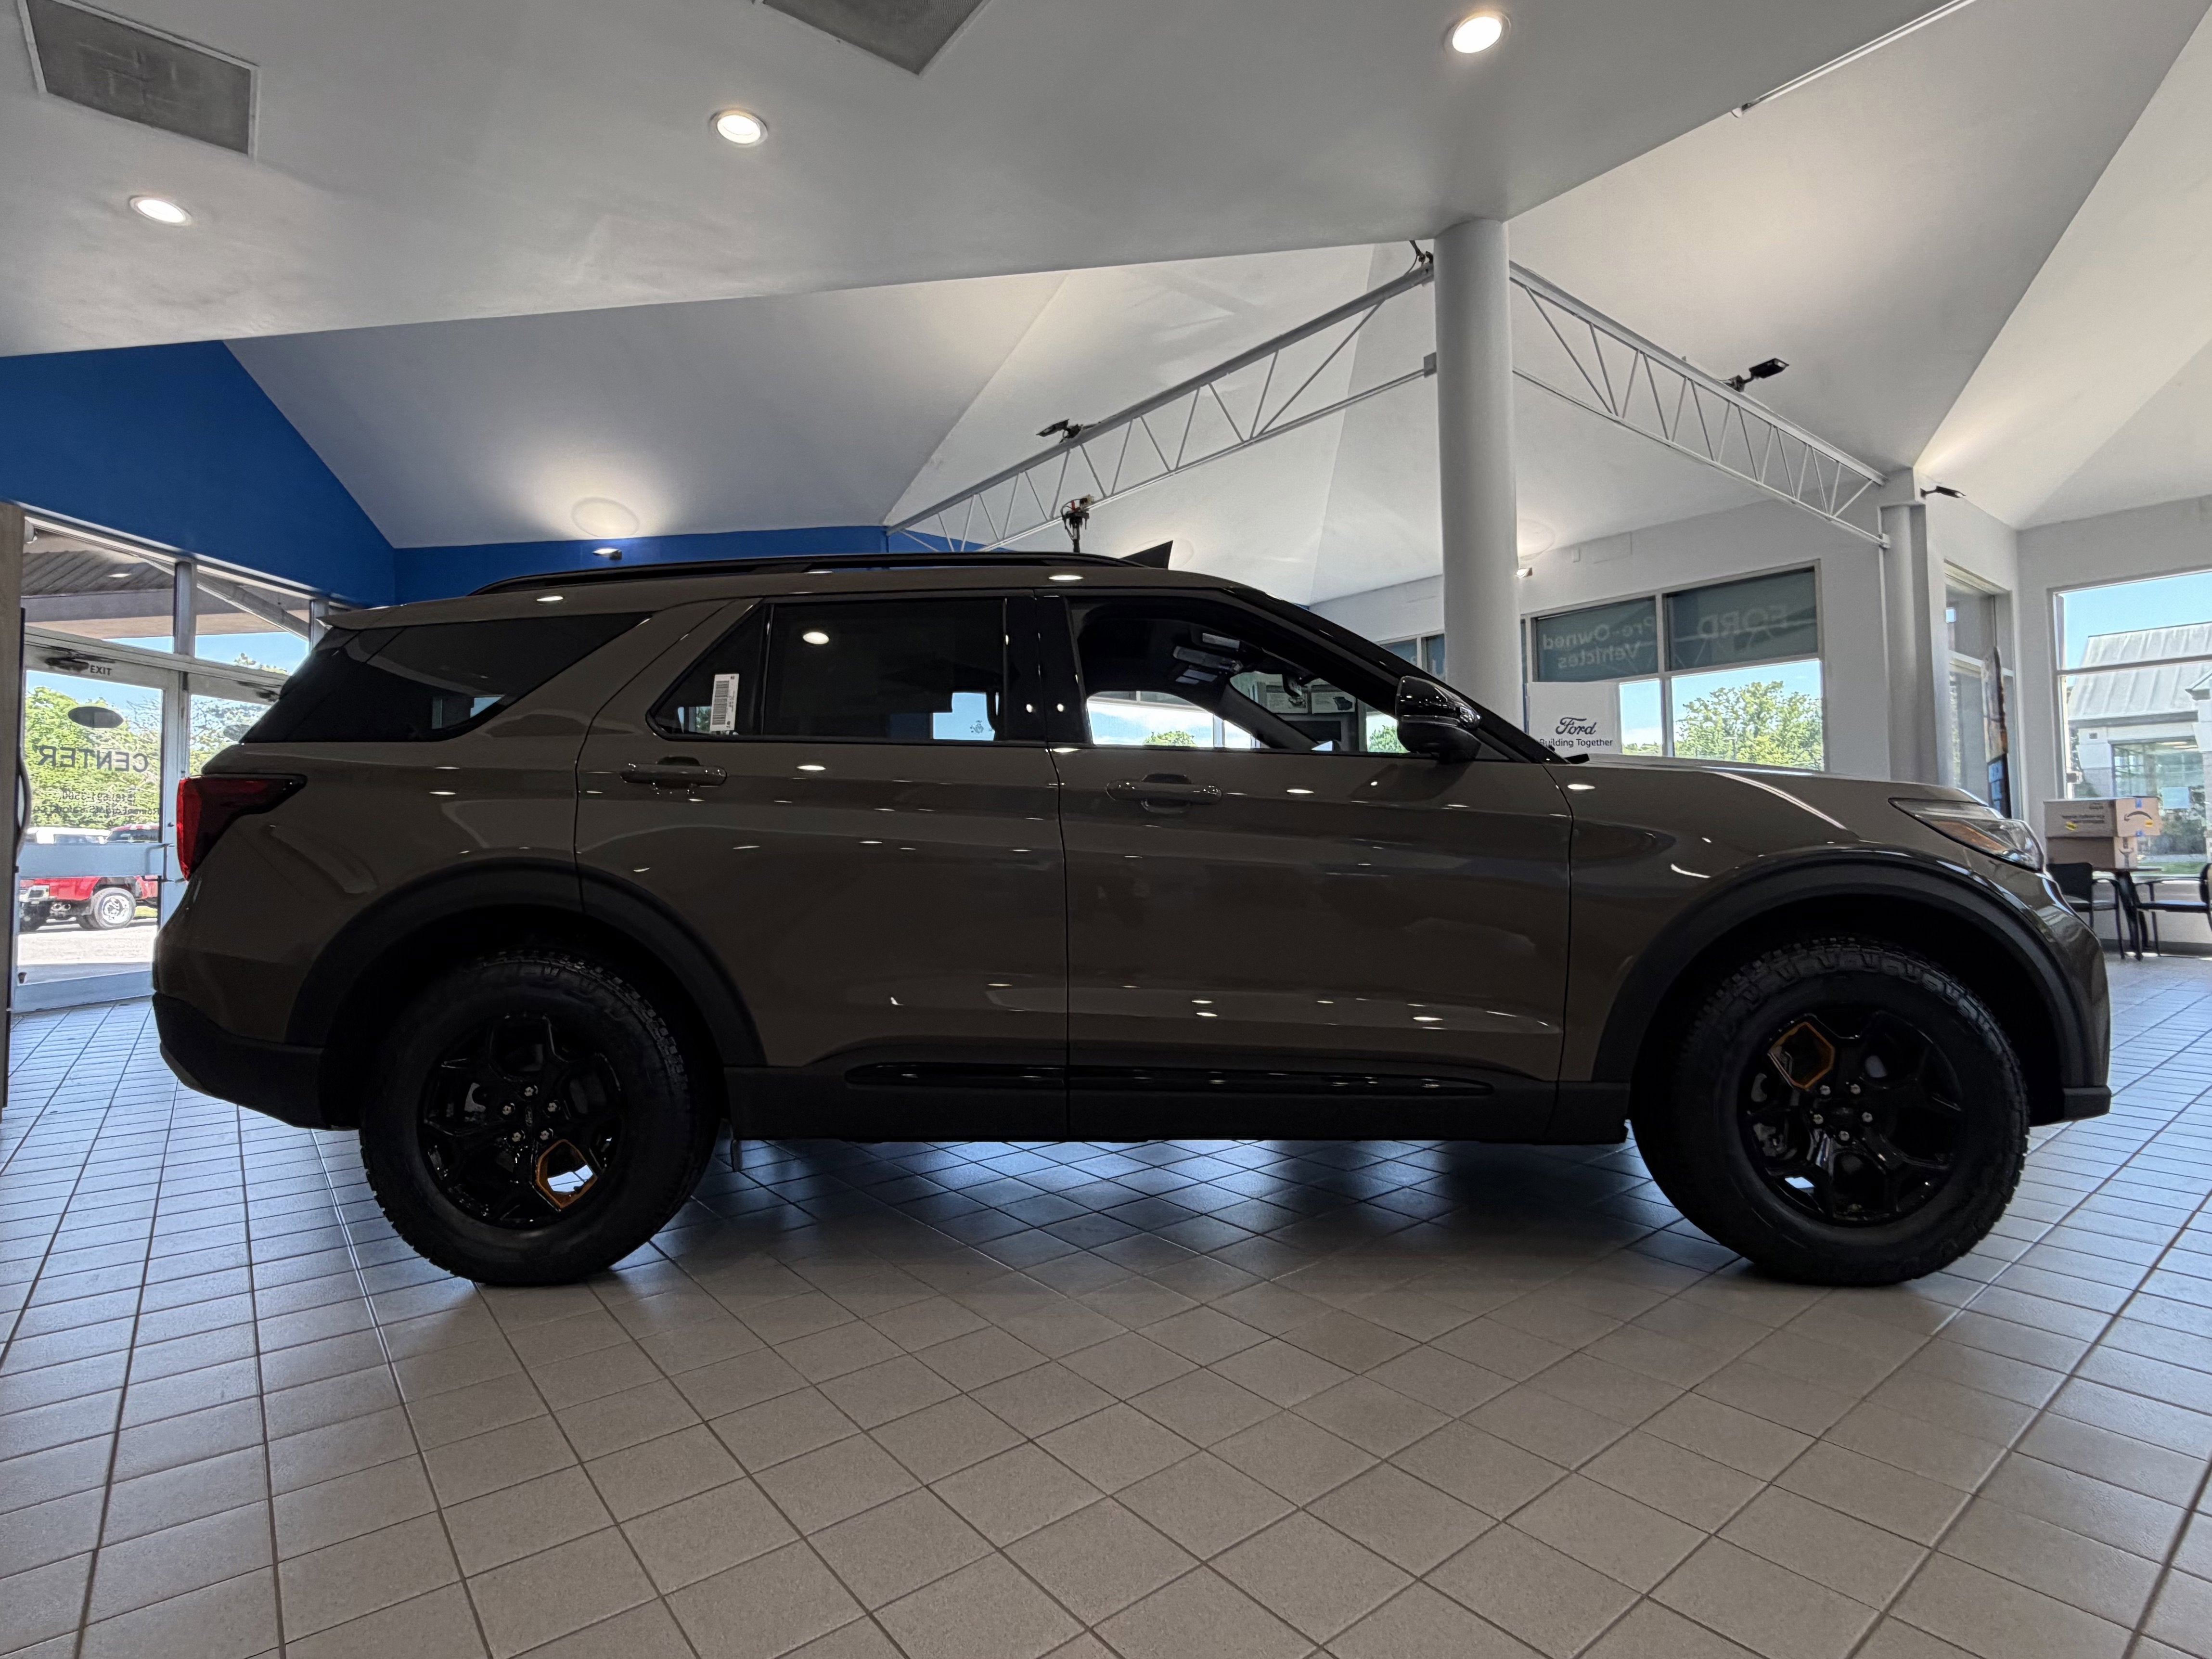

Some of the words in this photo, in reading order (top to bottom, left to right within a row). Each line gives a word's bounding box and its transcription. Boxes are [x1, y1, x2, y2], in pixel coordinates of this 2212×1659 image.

[90, 665, 112, 676] EXIT
[1555, 717, 1597, 735] Ford
[1540, 738, 1574, 748] Building
[1576, 738, 1613, 748] Together
